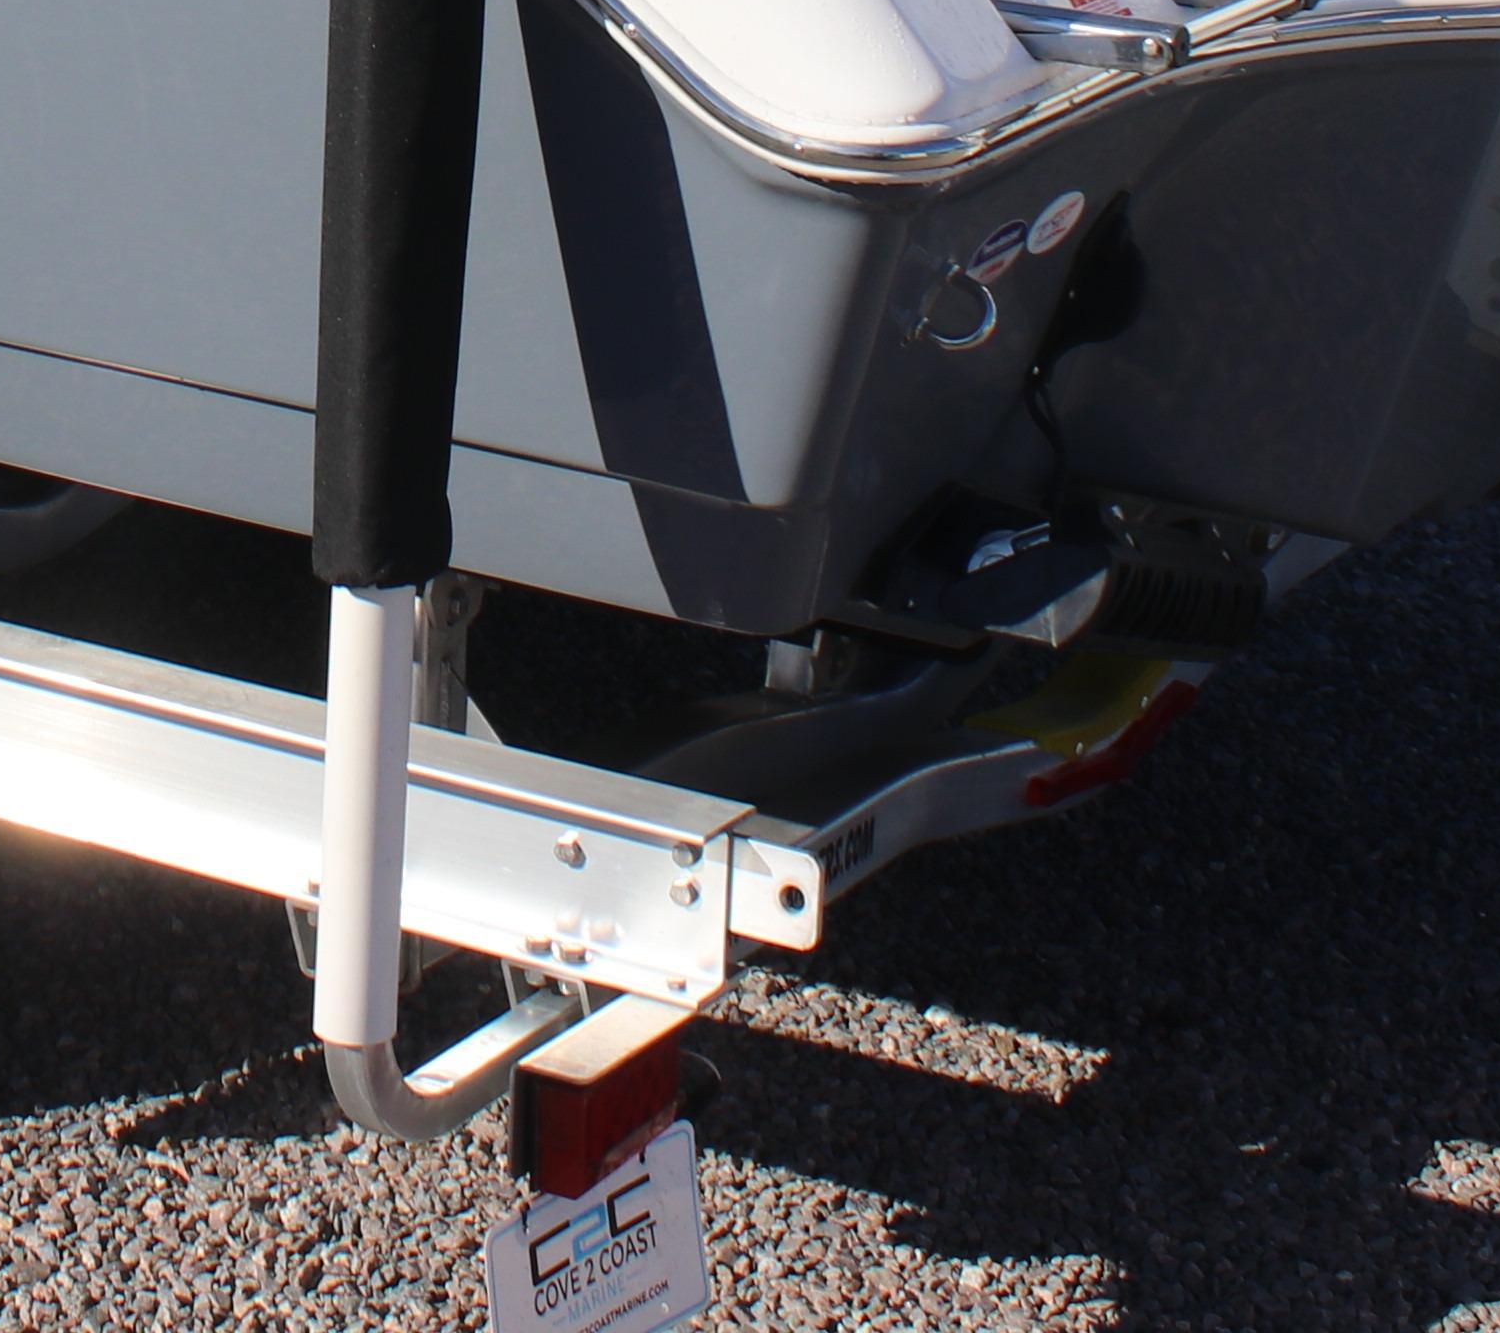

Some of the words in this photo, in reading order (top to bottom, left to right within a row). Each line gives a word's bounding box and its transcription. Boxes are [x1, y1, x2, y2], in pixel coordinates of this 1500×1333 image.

[529, 1173, 651, 1288] C2C
[534, 1264, 581, 1317] COVE
[585, 1257, 597, 1284] 2
[600, 1219, 658, 1276] COAST
[567, 1276, 628, 1324] MARINE
